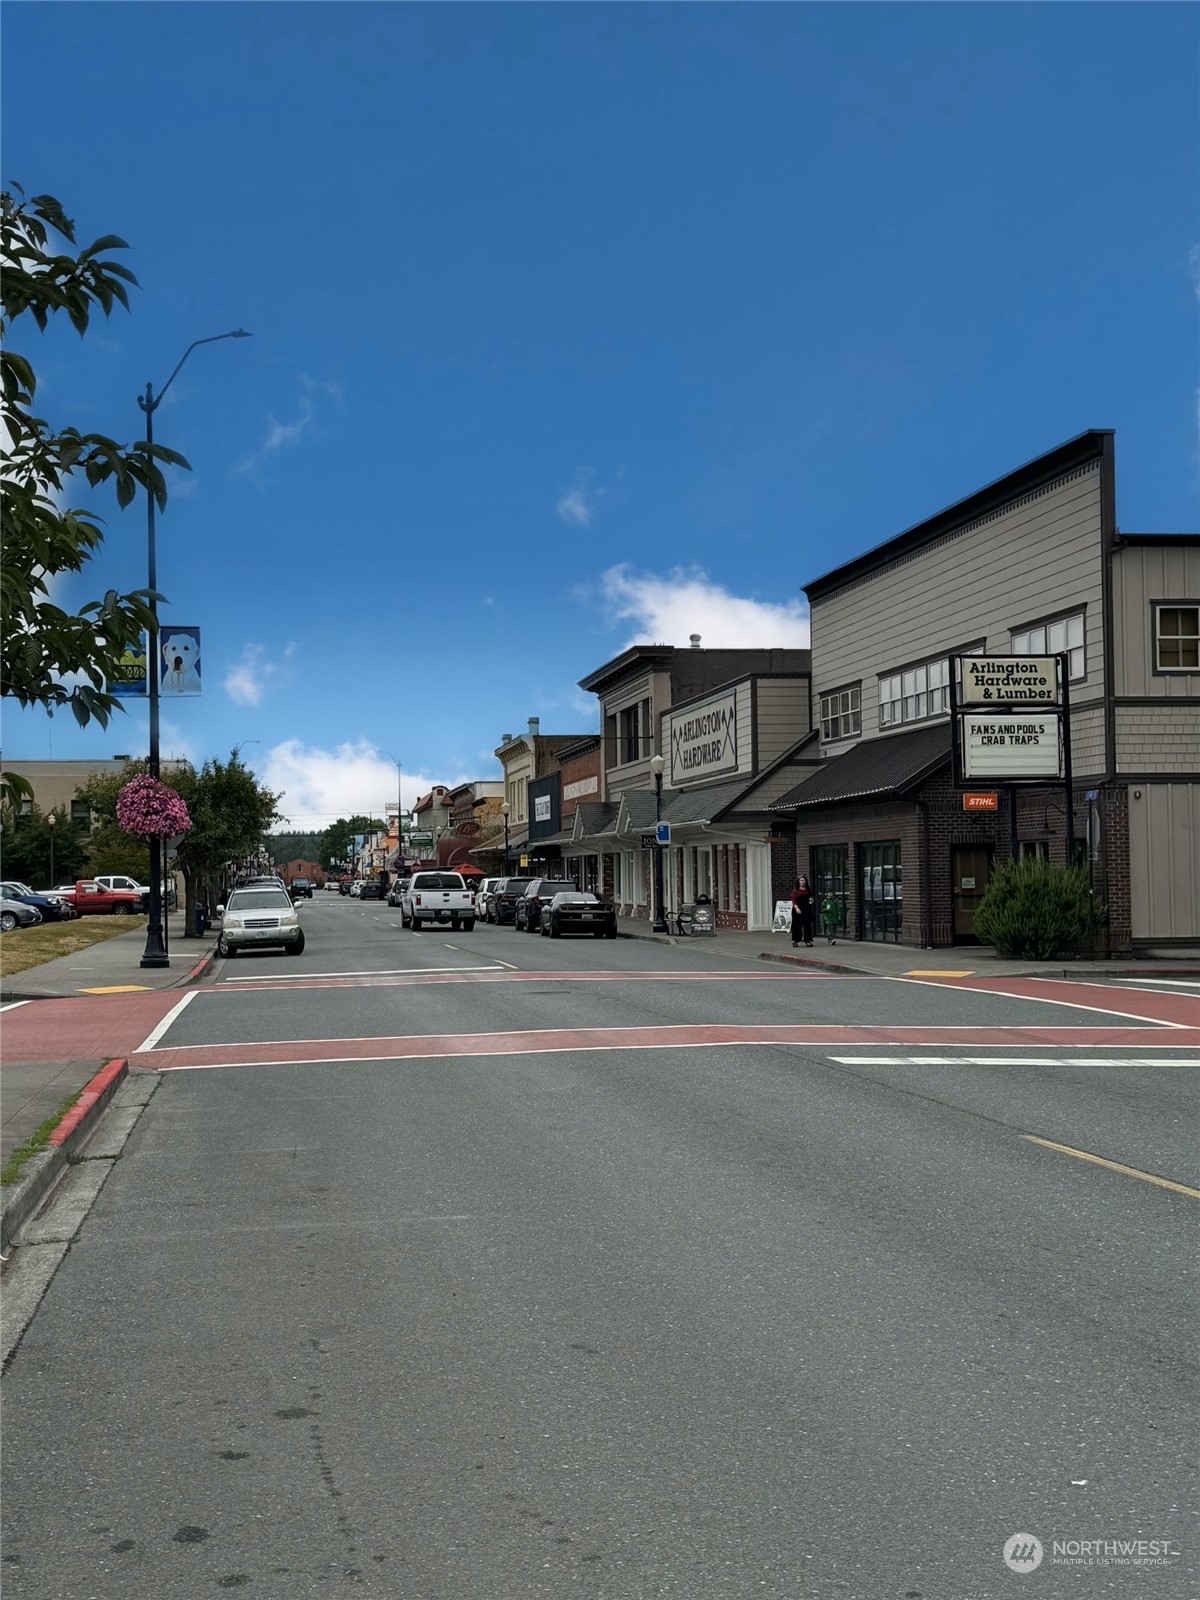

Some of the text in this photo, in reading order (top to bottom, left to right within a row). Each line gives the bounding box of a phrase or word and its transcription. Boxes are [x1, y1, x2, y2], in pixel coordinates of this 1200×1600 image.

[970, 663, 1038, 676] Arlington
[974, 675, 1047, 686] Hardware
[983, 688, 1053, 699] & Lumber
[683, 709, 722, 743] ARLINGTON
[971, 725, 1045, 735] FANS AND POOLS
[981, 735, 1040, 745] CRAB TRAPS
[683, 739, 722, 770] HARDWARE
[969, 798, 995, 806] STIHL
